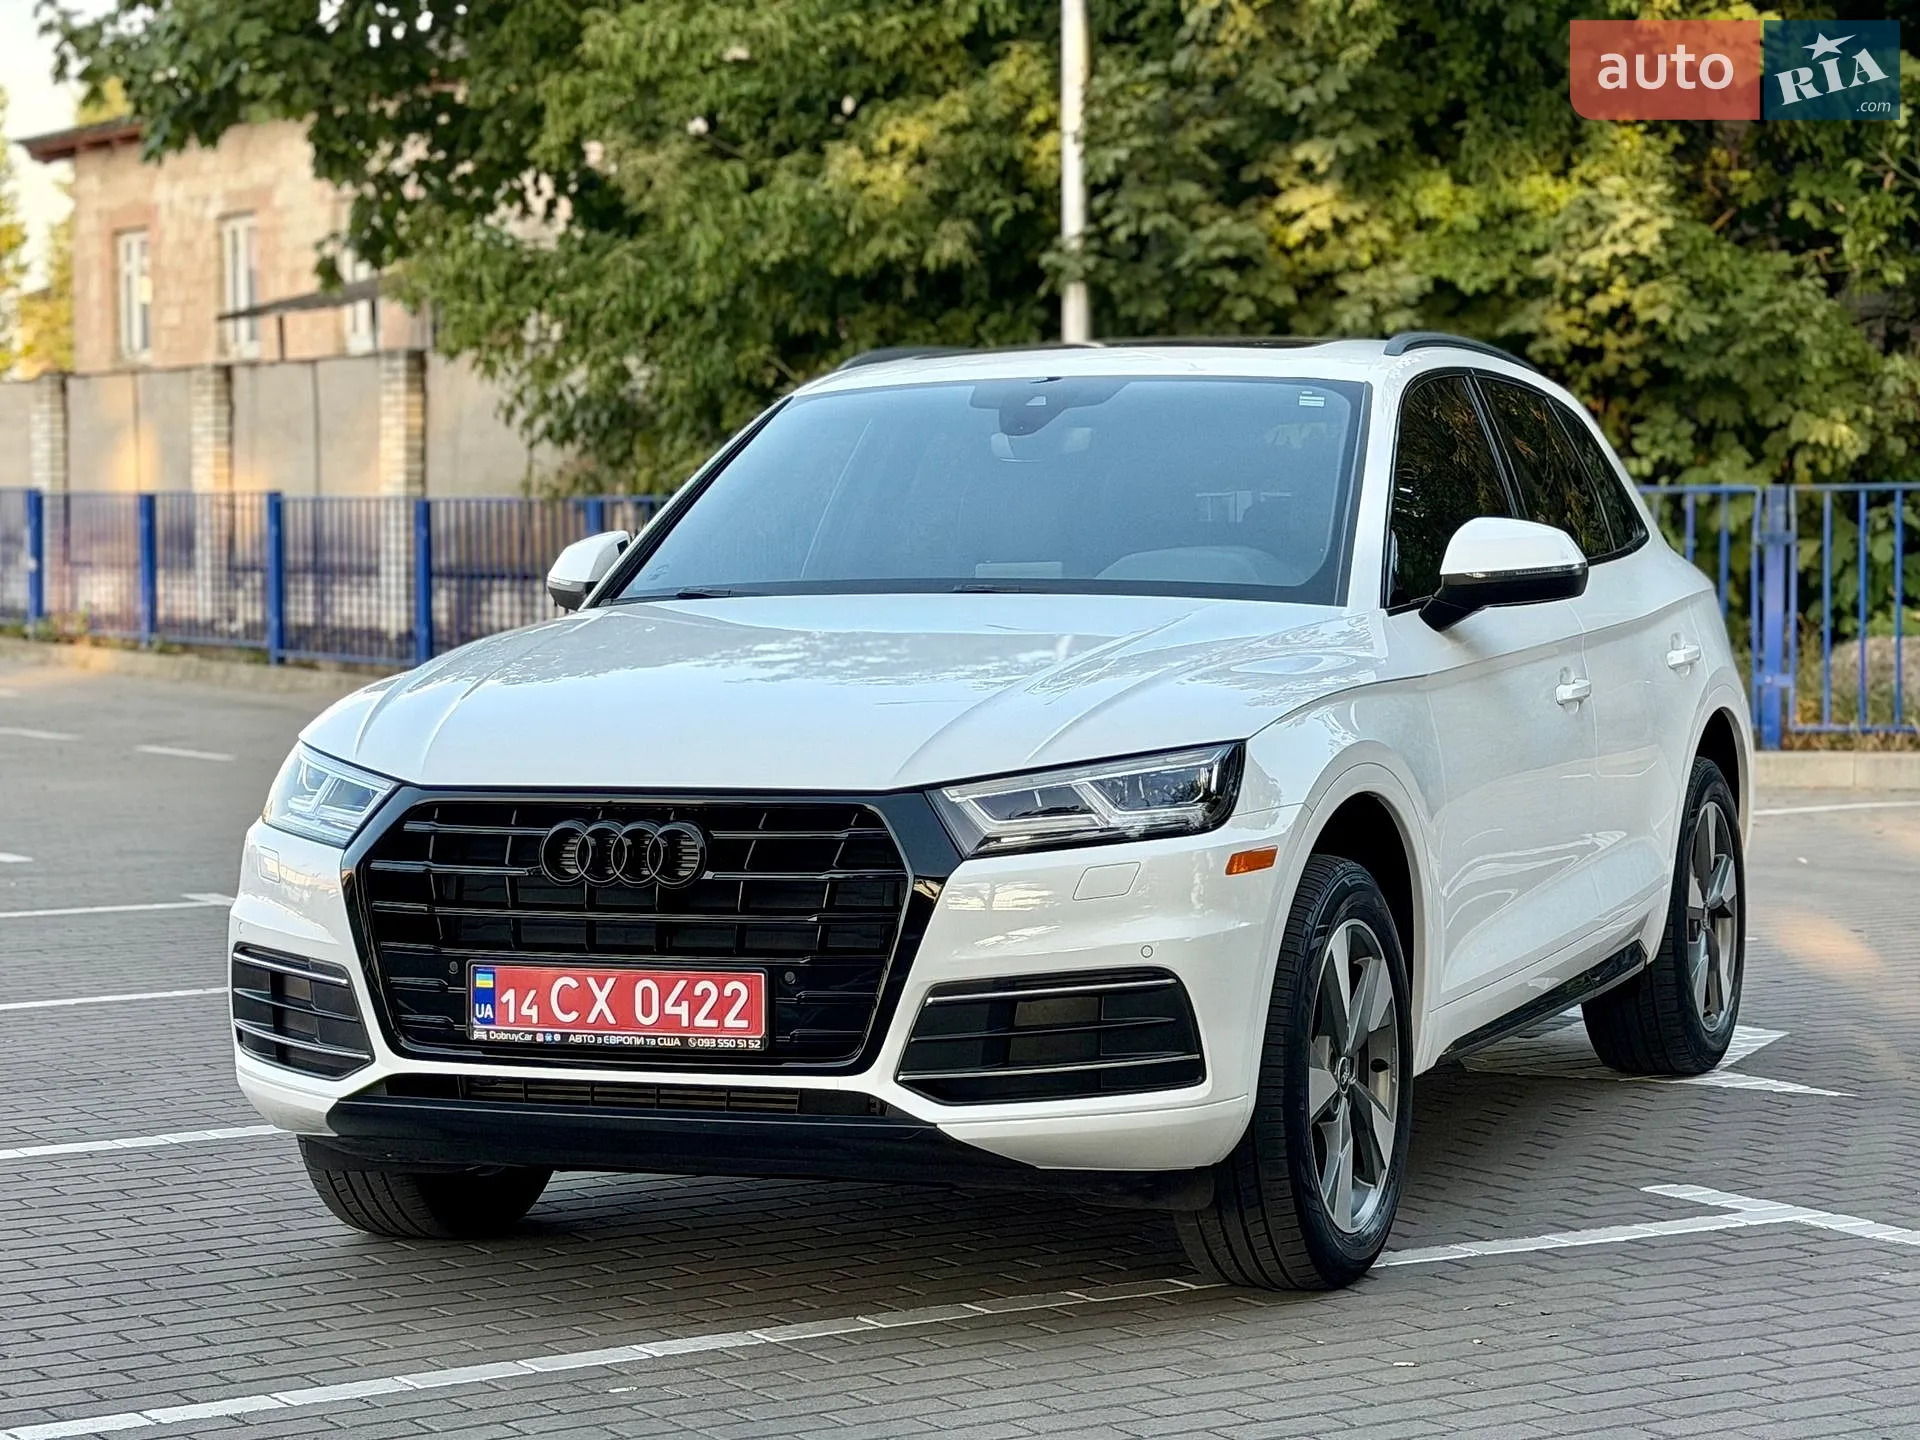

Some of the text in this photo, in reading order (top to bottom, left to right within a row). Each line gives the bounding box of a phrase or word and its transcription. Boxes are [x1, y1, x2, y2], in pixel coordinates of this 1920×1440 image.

[475, 1003, 494, 1020] UA
[500, 988, 539, 1025] 14
[634, 978, 750, 1029] 0422
[568, 1034, 596, 1044] АВТО
[657, 1037, 682, 1047] США
